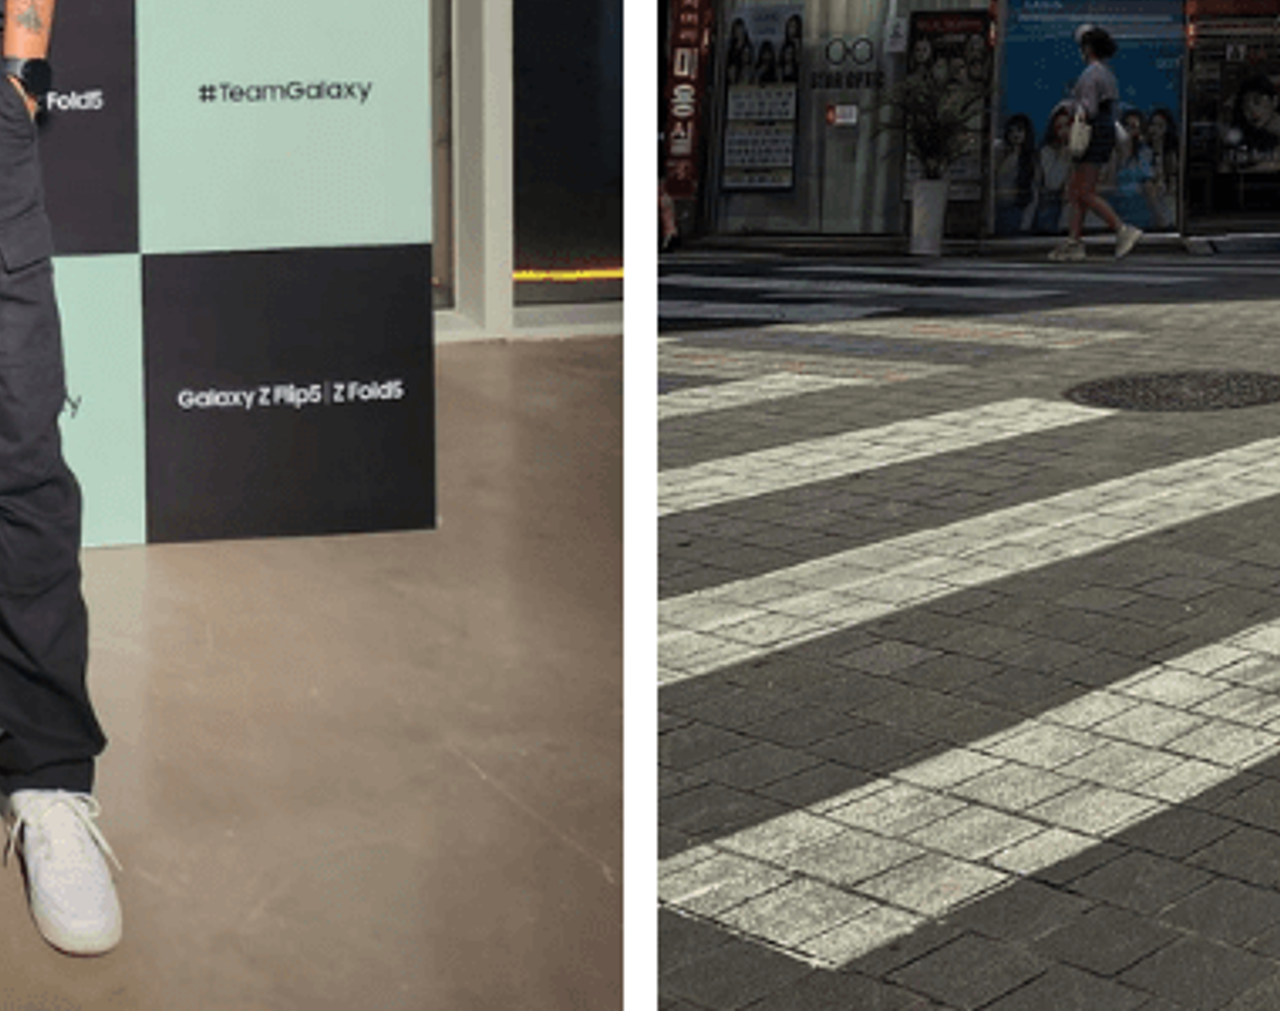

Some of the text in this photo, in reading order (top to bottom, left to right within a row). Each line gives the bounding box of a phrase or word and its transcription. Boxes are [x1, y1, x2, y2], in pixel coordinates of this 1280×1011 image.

[47, 91, 103, 110] Fold5
[199, 81, 371, 103] #TeamGalaxy
[178, 381, 403, 409] Galaxy Z Flip5 Z Fold5
